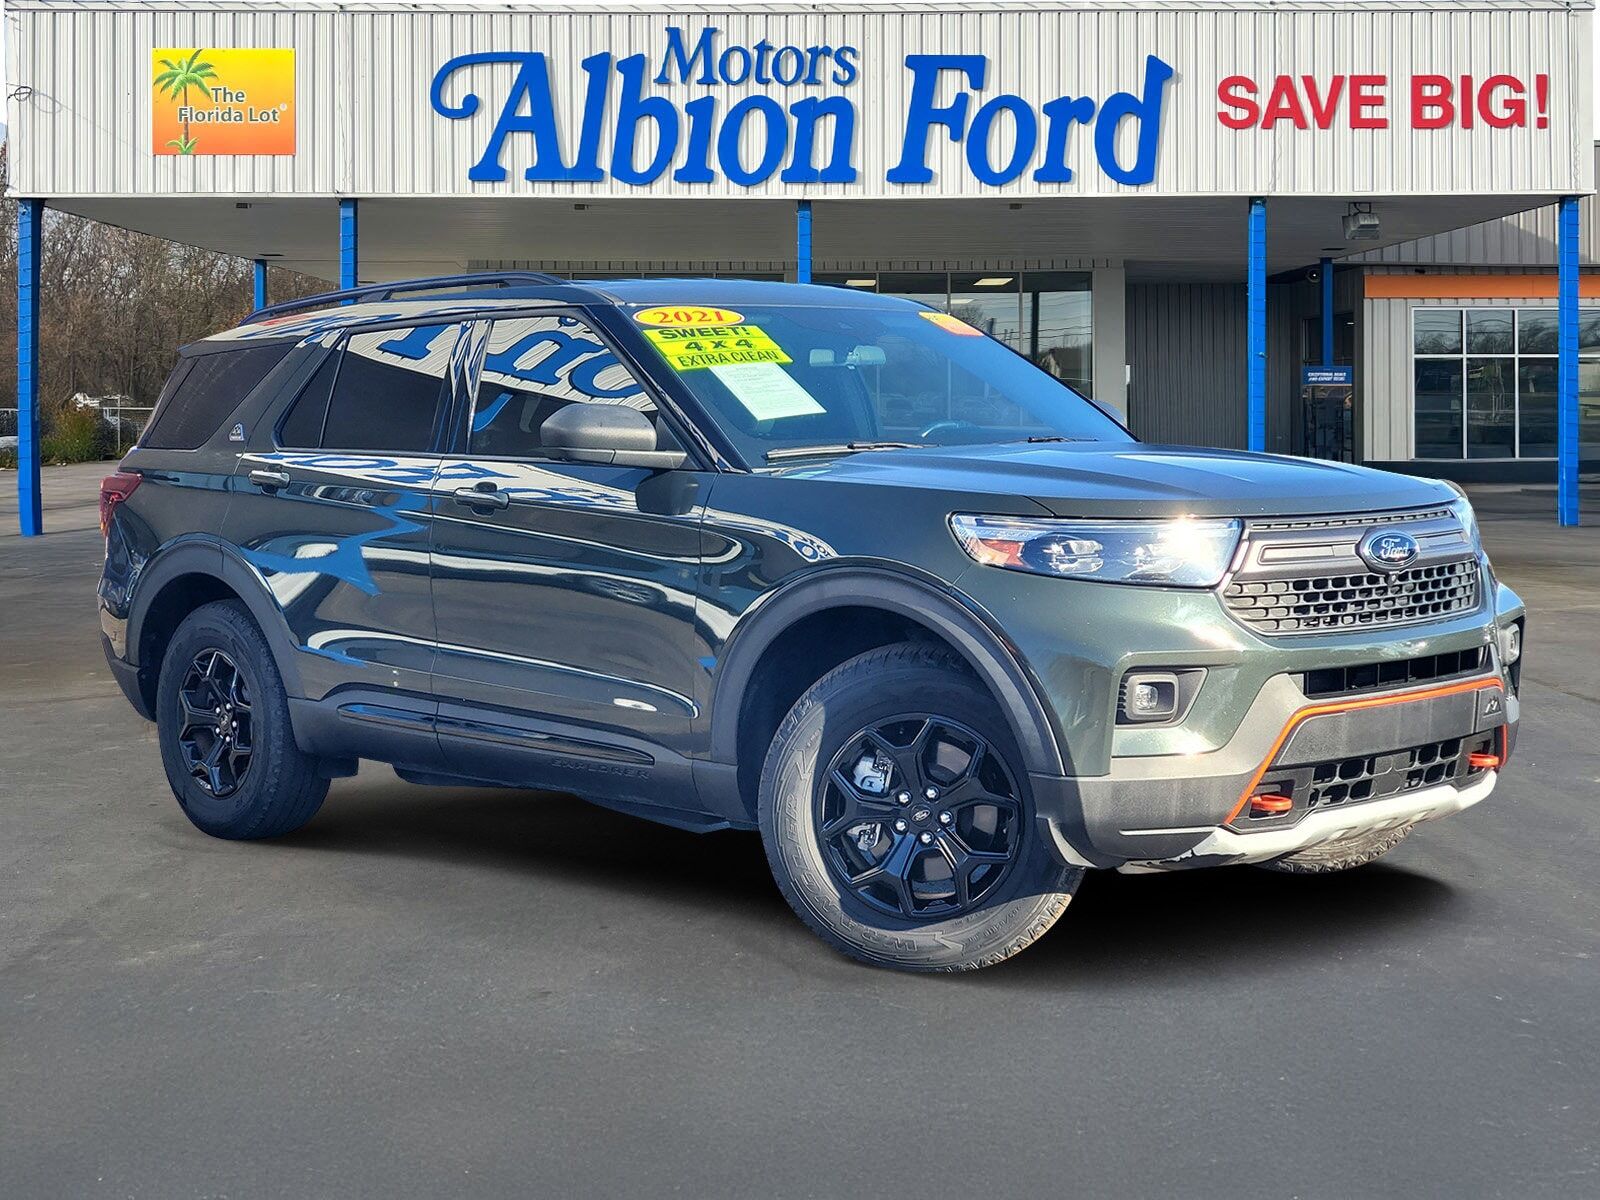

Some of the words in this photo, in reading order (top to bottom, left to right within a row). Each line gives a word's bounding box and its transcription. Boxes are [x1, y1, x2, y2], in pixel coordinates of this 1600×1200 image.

[653, 26, 858, 86] Motors
[210, 86, 246, 103] The
[1217, 74, 1389, 130] SAVE
[1410, 73, 1549, 130] BIG!
[178, 106, 244, 123] Florida
[248, 106, 279, 123] Lot
[430, 51, 859, 187] Albion
[886, 54, 1174, 187] Ford
[653, 310, 725, 325] 2021
[658, 326, 751, 340] SWEET!
[685, 340, 703, 352] 4
[735, 338, 754, 349] 4
[677, 353, 730, 368] EXTRA
[731, 350, 779, 363] CLEAN
[1381, 538, 1410, 559] Ford
